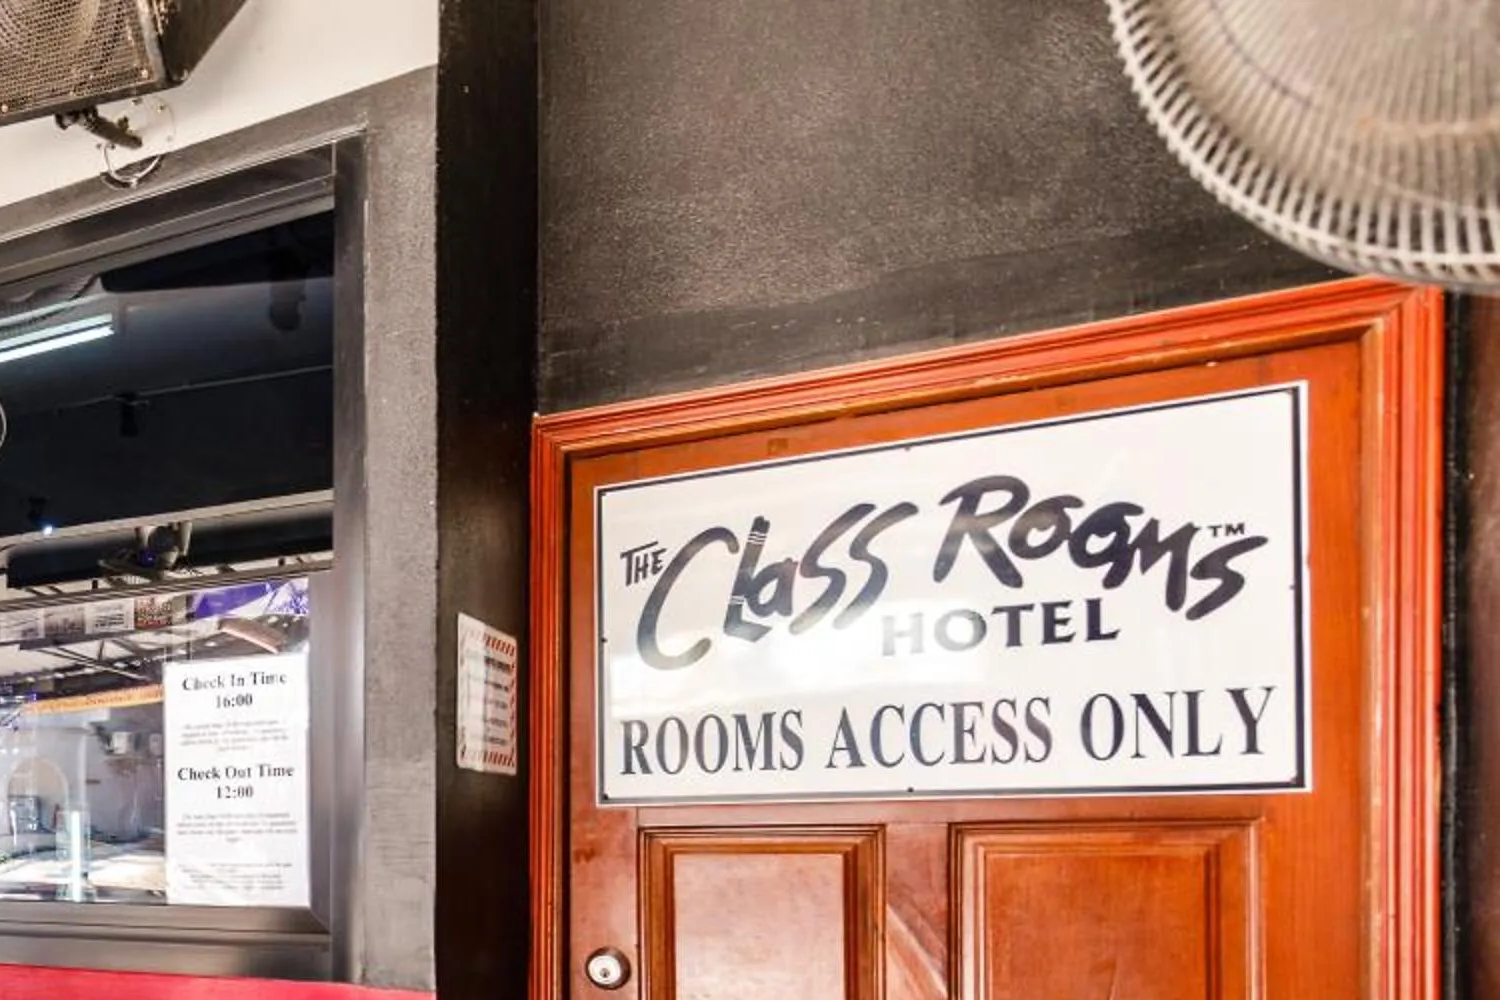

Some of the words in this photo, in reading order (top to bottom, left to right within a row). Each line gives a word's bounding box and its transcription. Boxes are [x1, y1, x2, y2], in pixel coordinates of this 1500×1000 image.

[620, 541, 668, 587] THE
[880, 597, 1121, 657] HOTEL
[181, 674, 225, 691] Check
[230, 673, 246, 687] In
[250, 671, 287, 686] Time
[216, 692, 254, 709] 16:00
[619, 709, 806, 777] ROOMS
[825, 695, 1054, 770] ACCESS
[1079, 685, 1276, 762] ONLY
[177, 766, 221, 782] Check
[225, 766, 252, 779] Out
[258, 763, 295, 778] Time
[216, 785, 255, 800] 12:00
